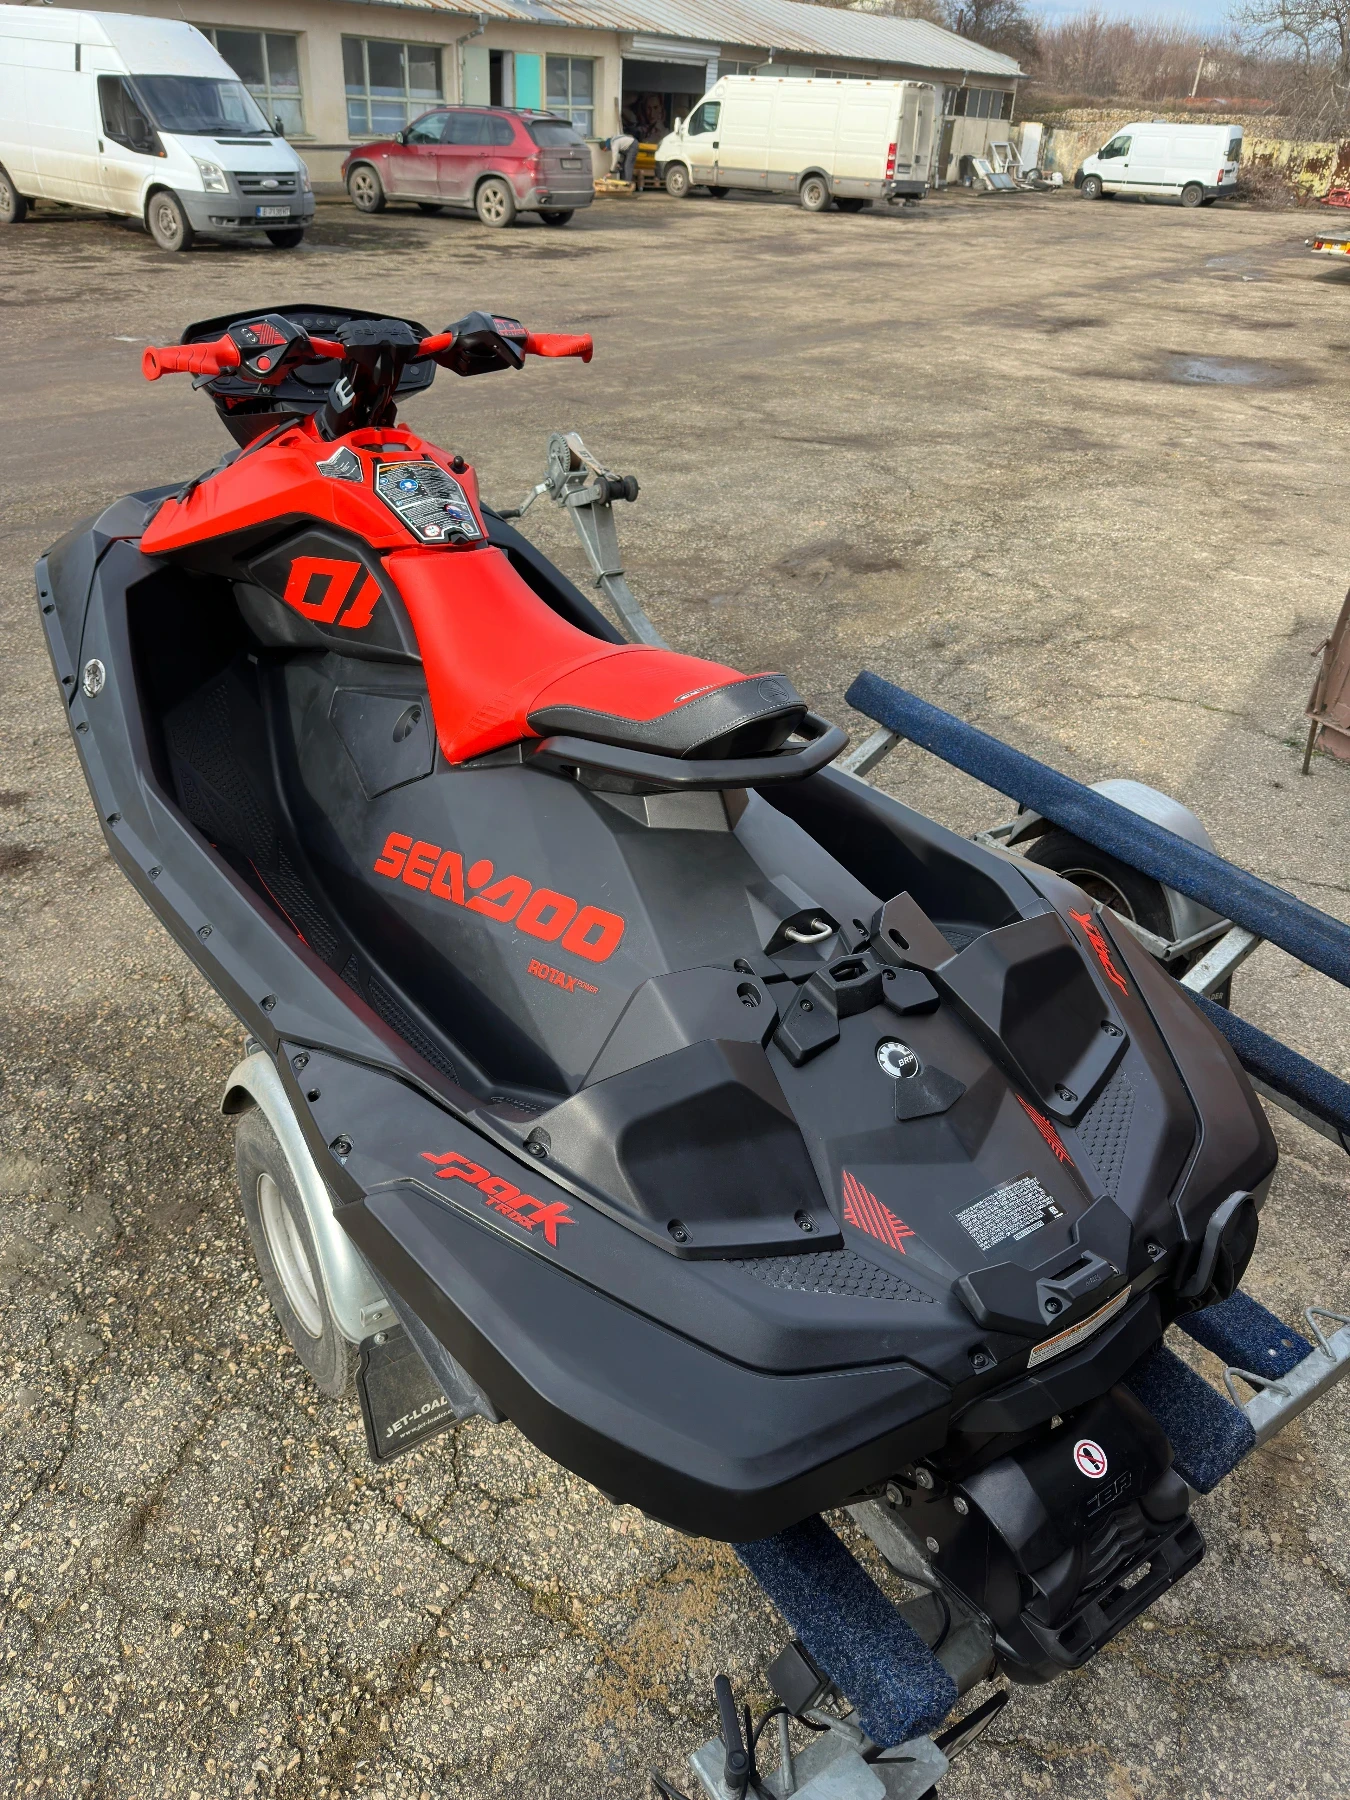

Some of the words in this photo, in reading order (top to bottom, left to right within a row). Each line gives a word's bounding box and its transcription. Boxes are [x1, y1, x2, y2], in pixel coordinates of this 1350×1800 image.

[527, 958, 577, 993] ROTAX
[575, 979, 599, 994] POWER
[898, 1054, 914, 1067] BRP
